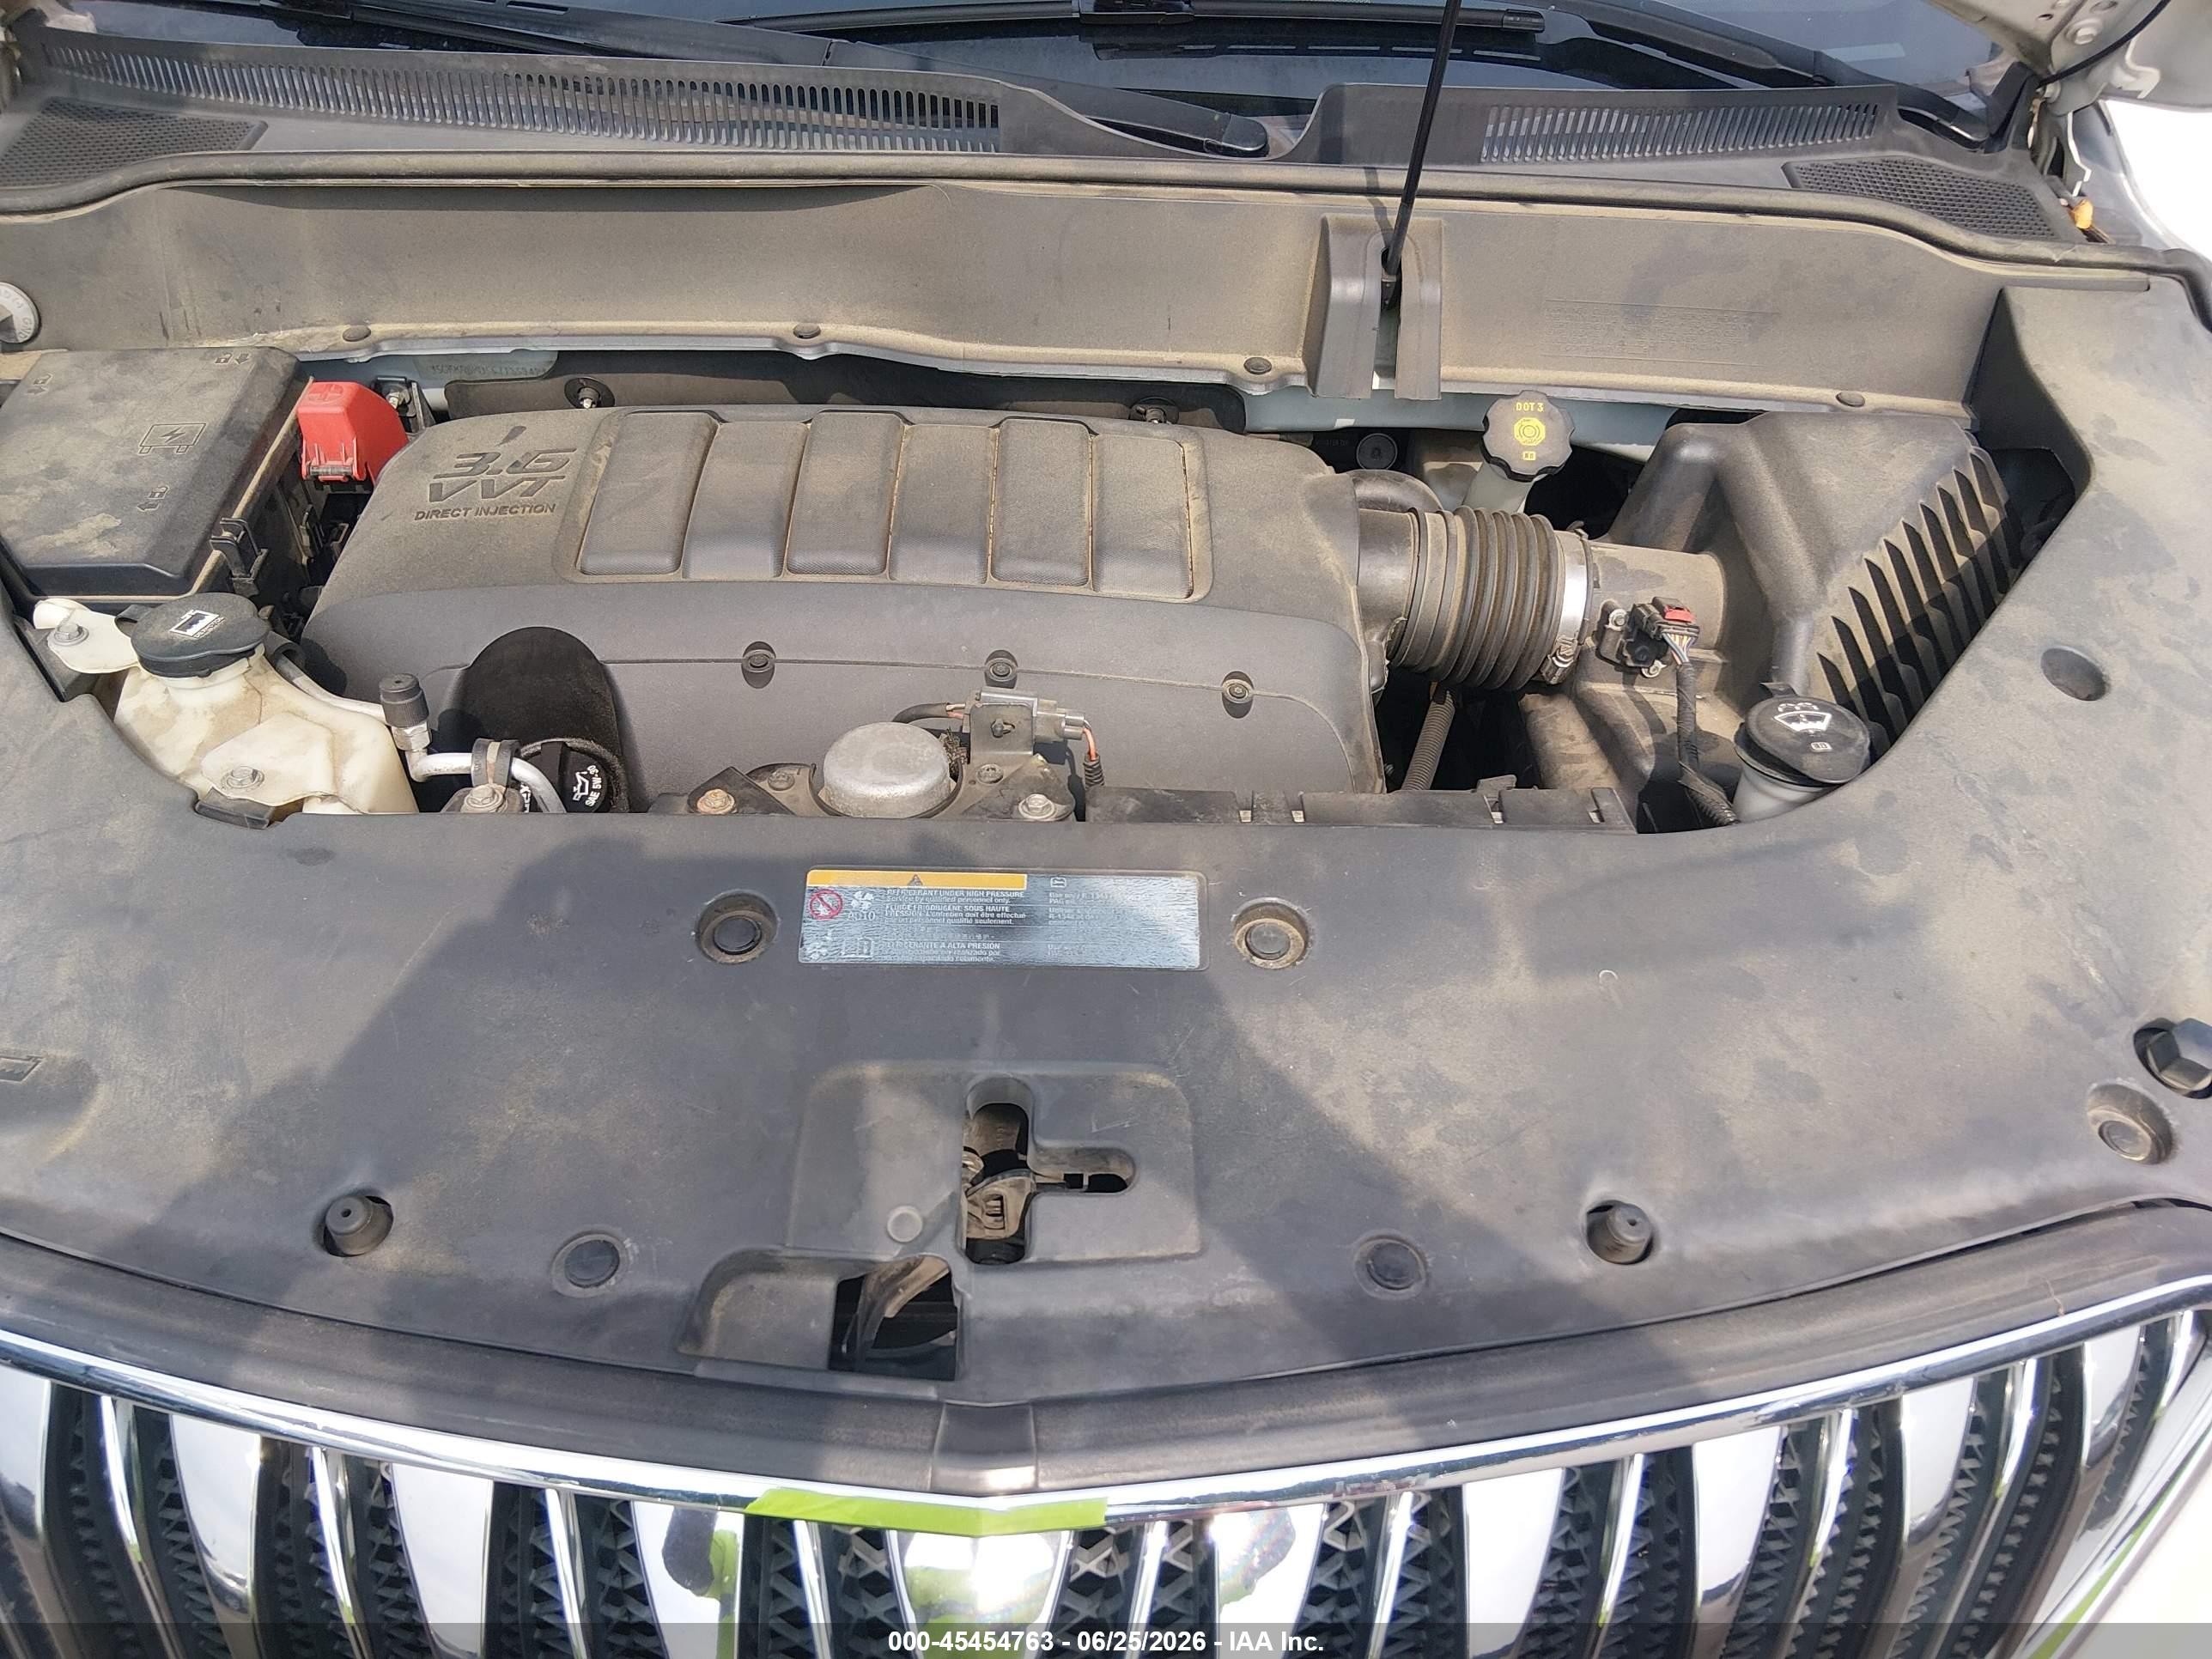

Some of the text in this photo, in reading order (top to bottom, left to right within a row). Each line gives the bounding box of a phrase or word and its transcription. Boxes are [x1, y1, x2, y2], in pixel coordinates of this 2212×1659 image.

[1516, 401, 1545, 412] DOT 3
[433, 447, 577, 479] 3.6
[429, 475, 566, 502] VVT
[414, 503, 556, 520] DIRECT INJECTION
[585, 764, 602, 807] SAE 5W-30
